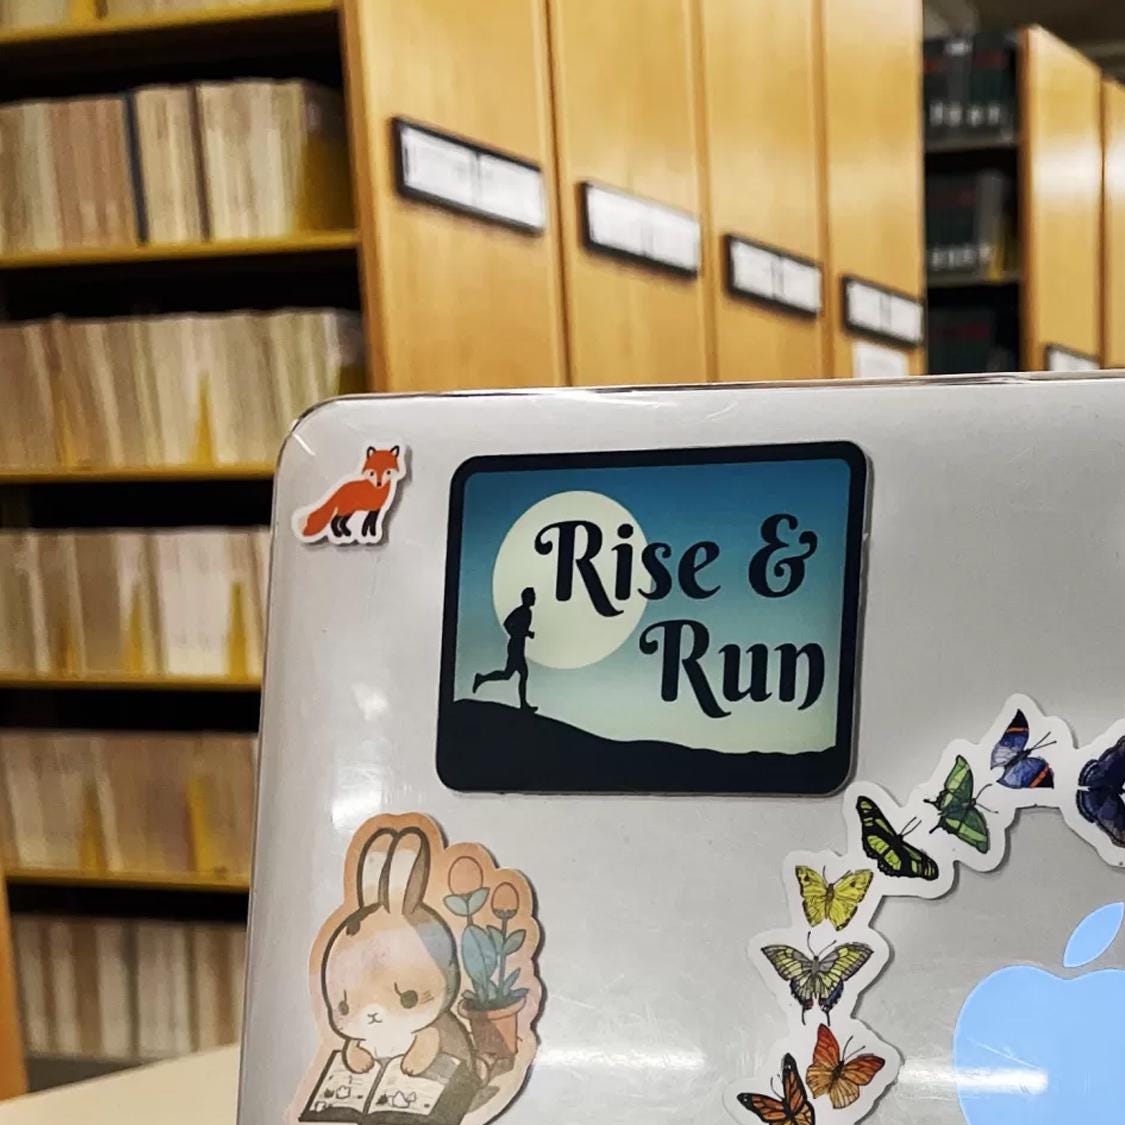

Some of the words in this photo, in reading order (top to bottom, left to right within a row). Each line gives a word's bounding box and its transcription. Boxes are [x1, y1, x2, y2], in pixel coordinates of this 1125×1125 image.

[534, 519, 721, 618] Rise
[748, 513, 818, 598] &
[639, 619, 825, 719] Run
